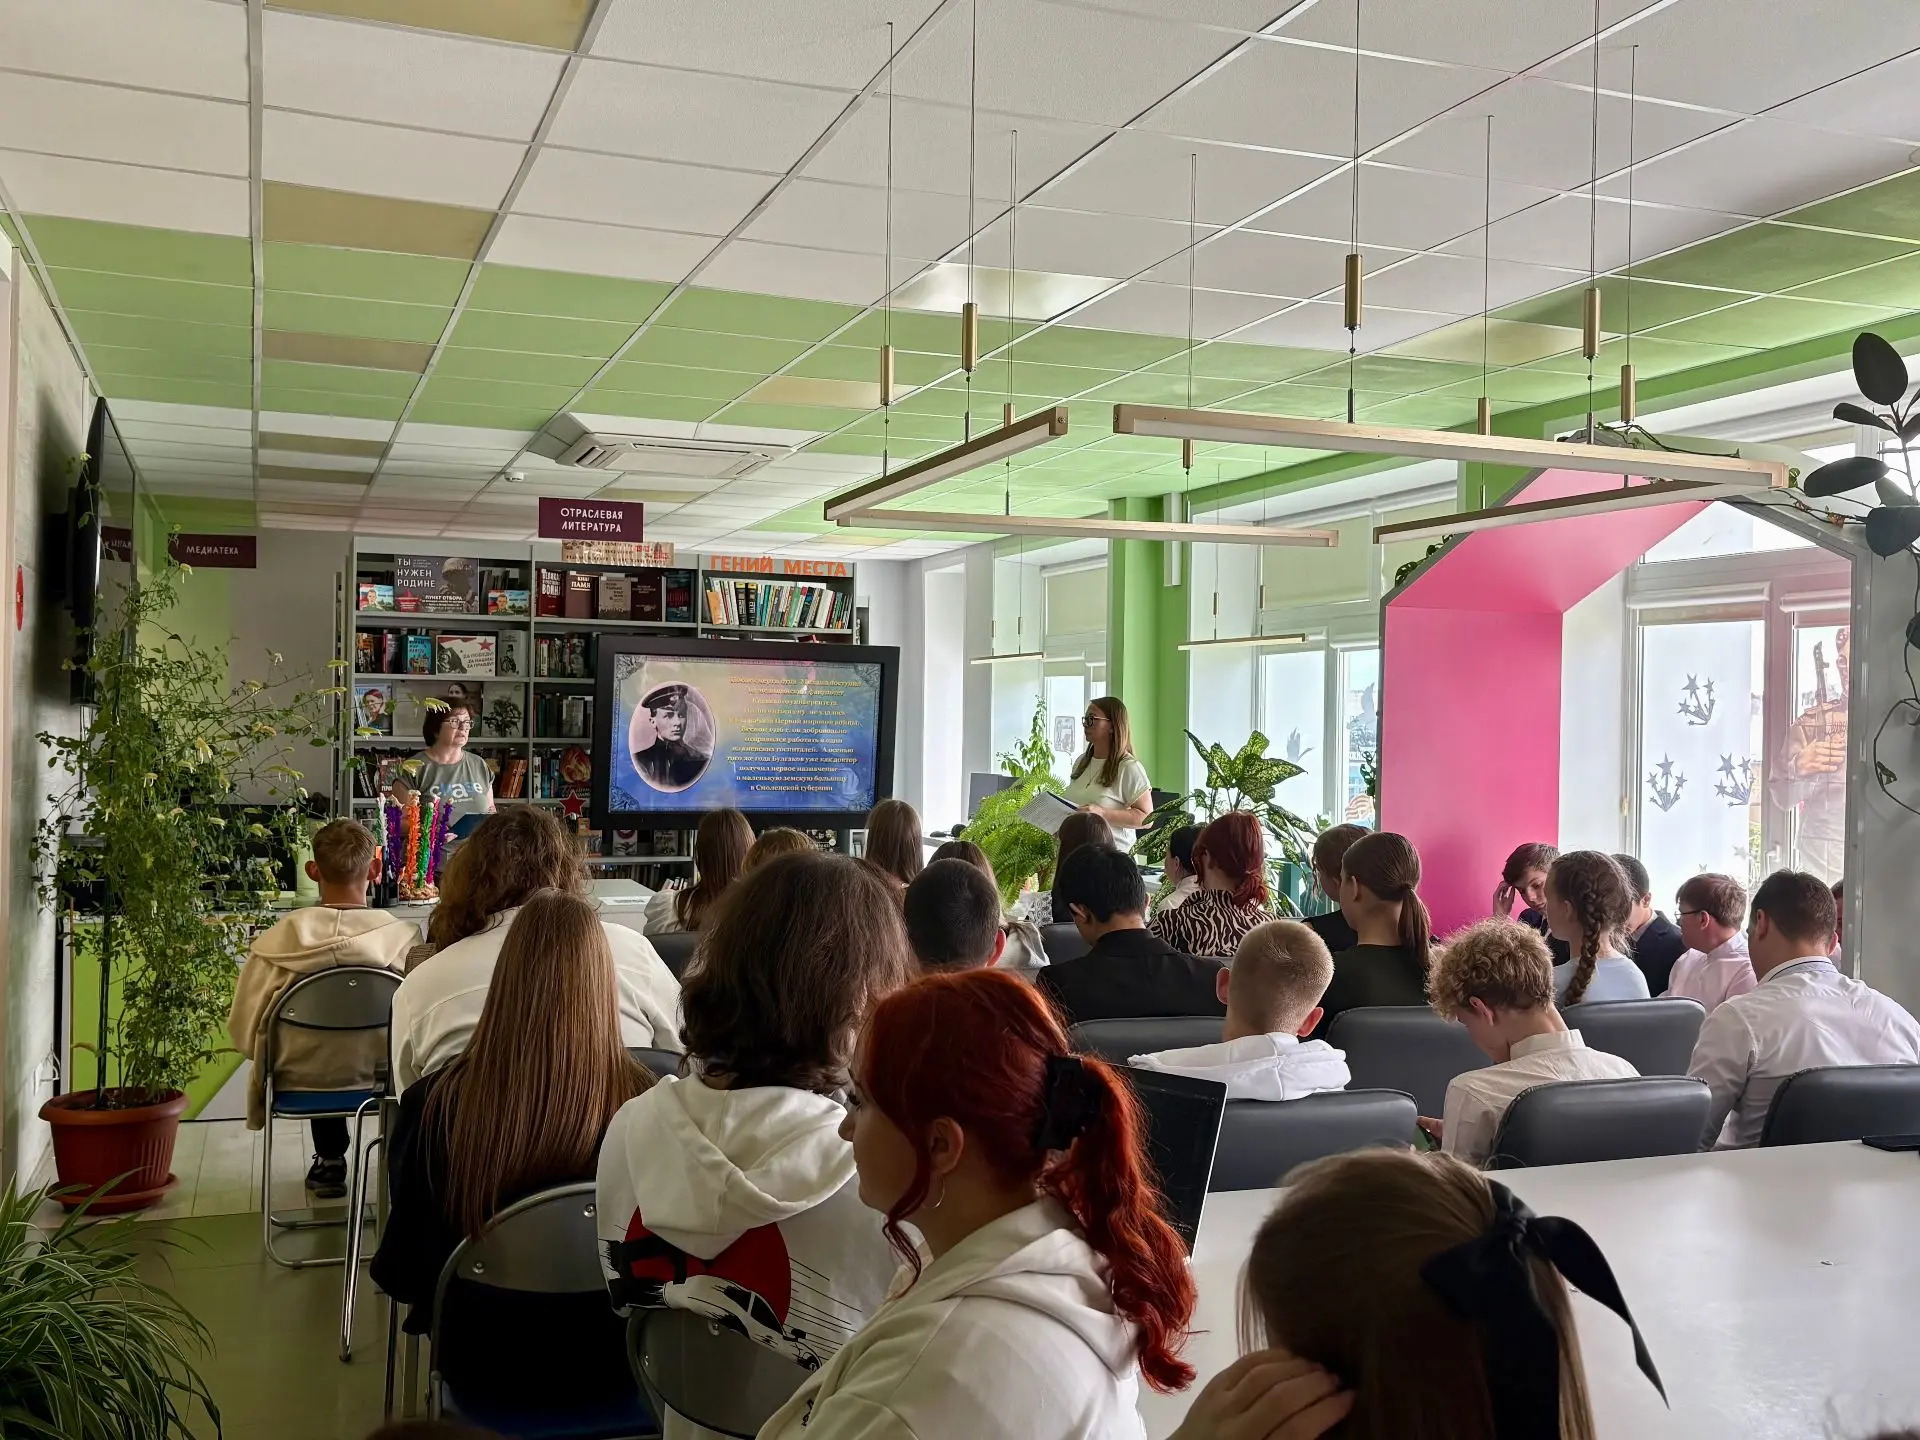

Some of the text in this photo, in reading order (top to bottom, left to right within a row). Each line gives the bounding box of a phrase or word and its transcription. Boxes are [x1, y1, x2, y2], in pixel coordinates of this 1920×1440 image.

[560, 507, 624, 520] ОТРАСЛЕВАЯ
[561, 520, 622, 533] ЛИТЕРАТУРА
[186, 545, 239, 556] МЕДИАТЕКА
[397, 558, 411, 567] ТЫ
[710, 555, 847, 576] ГЕНИЙ МЕСТА
[397, 568, 432, 578] НУЖЕН
[397, 579, 436, 589] РОДИНЕ
